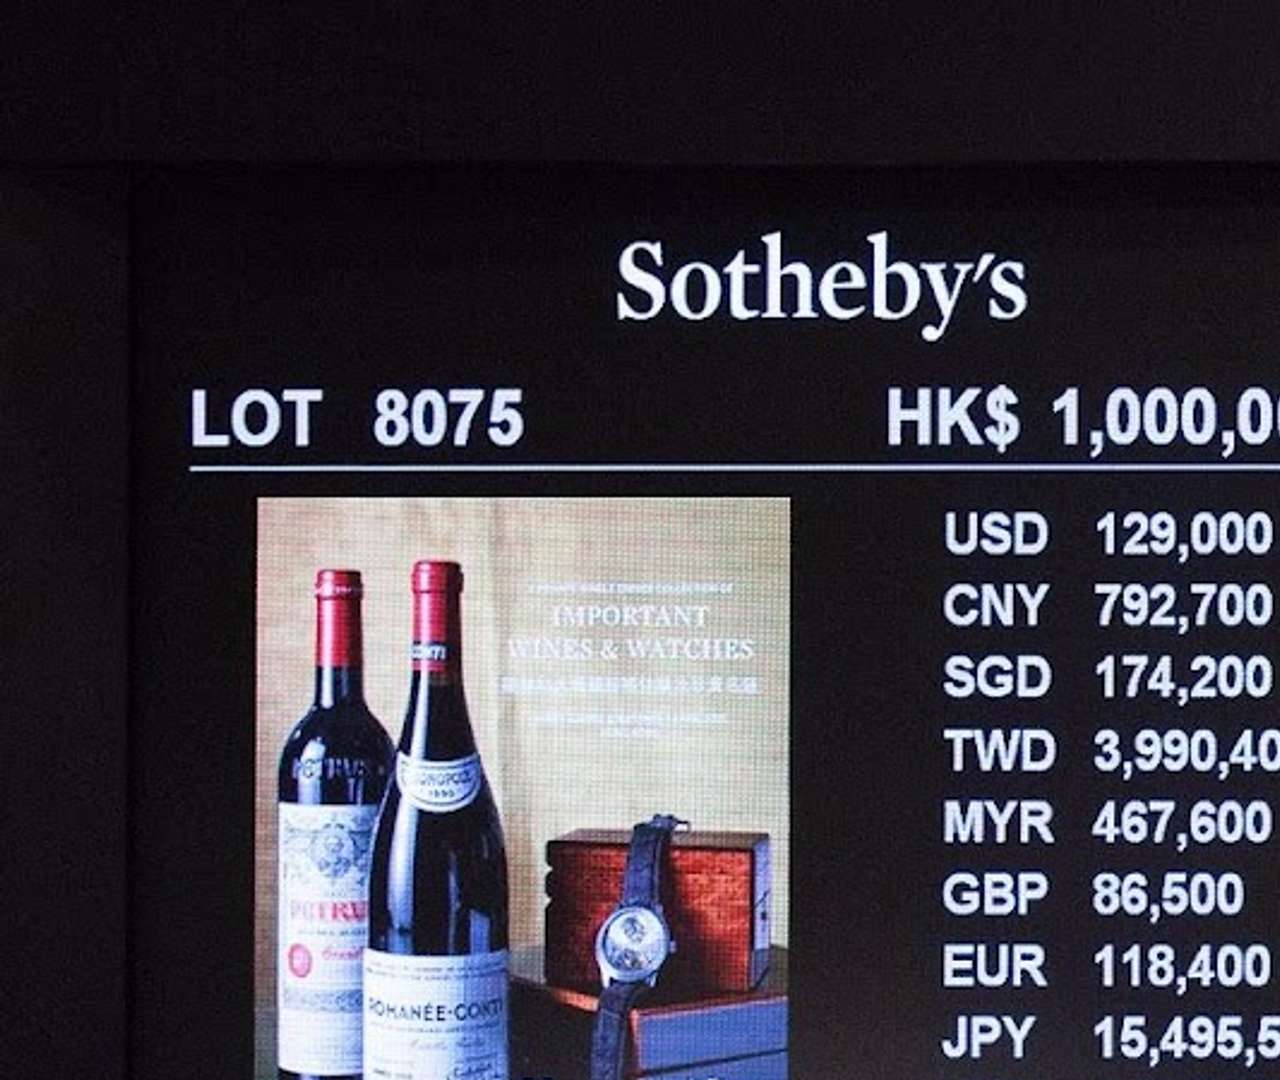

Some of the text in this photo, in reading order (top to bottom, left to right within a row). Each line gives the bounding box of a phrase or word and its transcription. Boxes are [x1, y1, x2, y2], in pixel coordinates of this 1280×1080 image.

[618, 231, 1027, 341] Sotheby's
[193, 390, 322, 446] LOT
[375, 389, 523, 445] 8075
[889, 385, 1019, 453] HK$
[946, 512, 1272, 562] USD 129,000
[553, 604, 710, 628] IMPORTANT
[944, 584, 1272, 634] CNY 792,700
[507, 638, 756, 660] WINES & WATCHES
[944, 655, 1272, 706] SGD 174,200
[944, 729, 1055, 771] TWD
[944, 801, 1271, 851] MYR 467,600
[943, 873, 1243, 923] GBP 86,500
[944, 944, 1270, 995] EUR 118,400
[942, 1016, 1035, 1058] JPY
